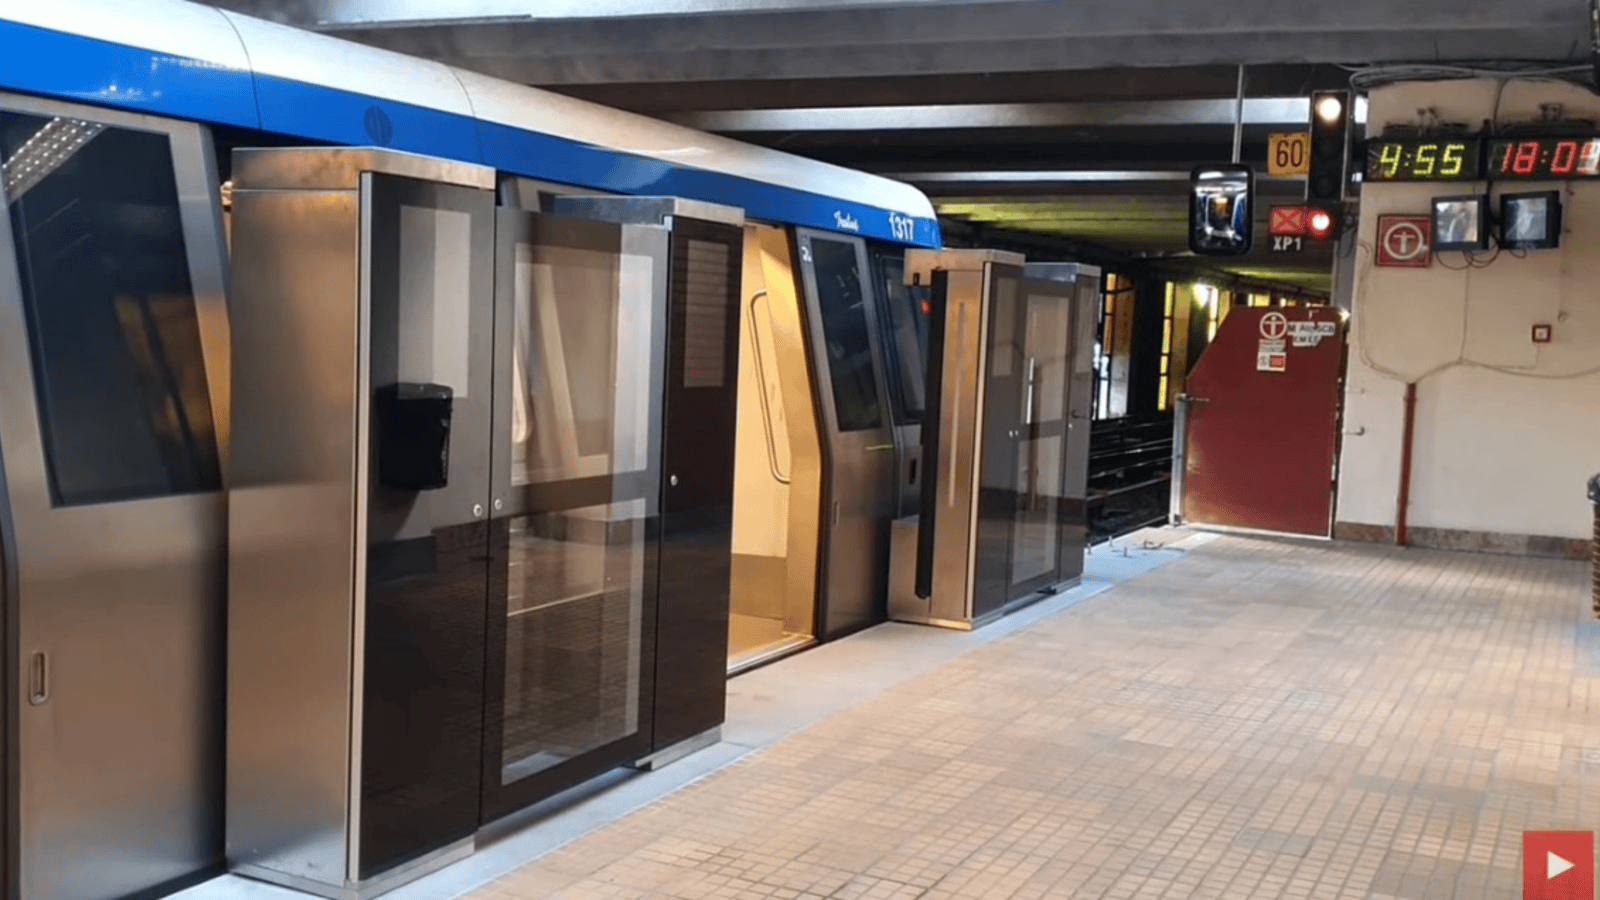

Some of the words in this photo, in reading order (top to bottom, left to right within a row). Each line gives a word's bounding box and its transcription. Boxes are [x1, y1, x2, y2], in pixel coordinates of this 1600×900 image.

[1276, 139, 1303, 168] 60
[1380, 144, 1465, 175] 4:55
[888, 211, 914, 241] 1317
[1273, 235, 1302, 251] XP1
